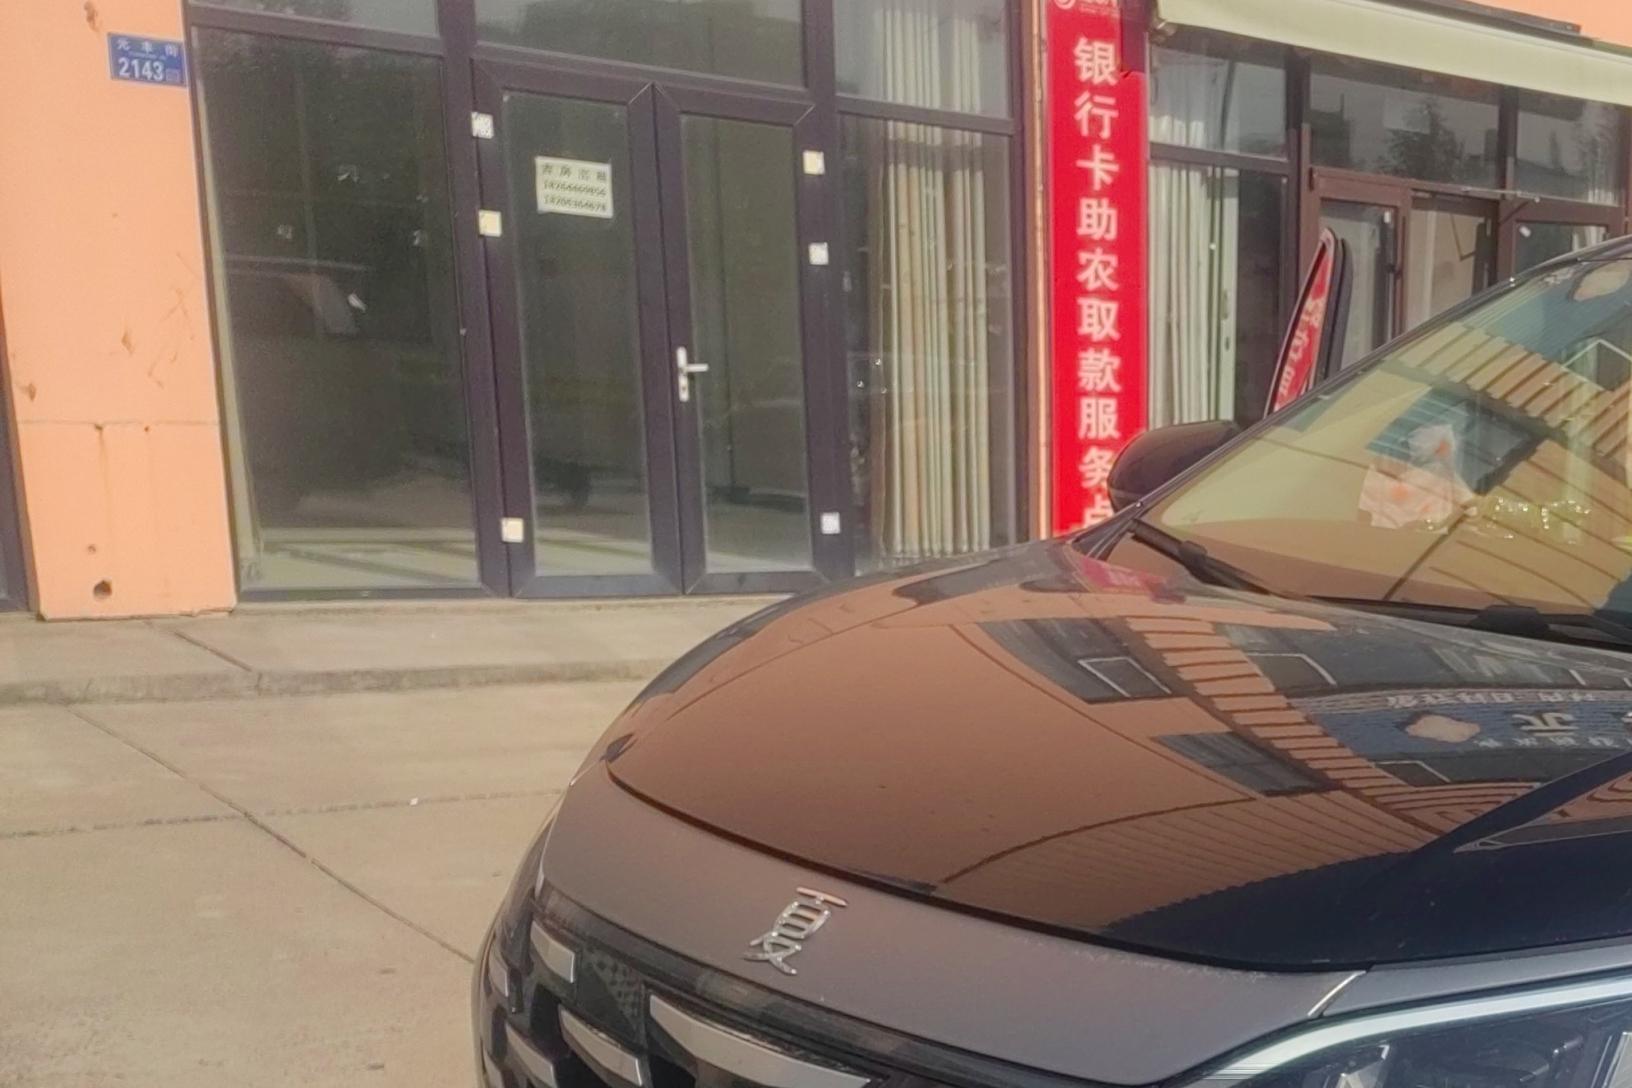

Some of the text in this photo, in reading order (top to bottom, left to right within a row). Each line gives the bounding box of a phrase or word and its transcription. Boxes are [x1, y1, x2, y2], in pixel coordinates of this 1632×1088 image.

[118, 57, 164, 82] 2143
[1073, 35, 1119, 526] 银行卡助农取款服务点
[743, 886, 848, 976] 夏
